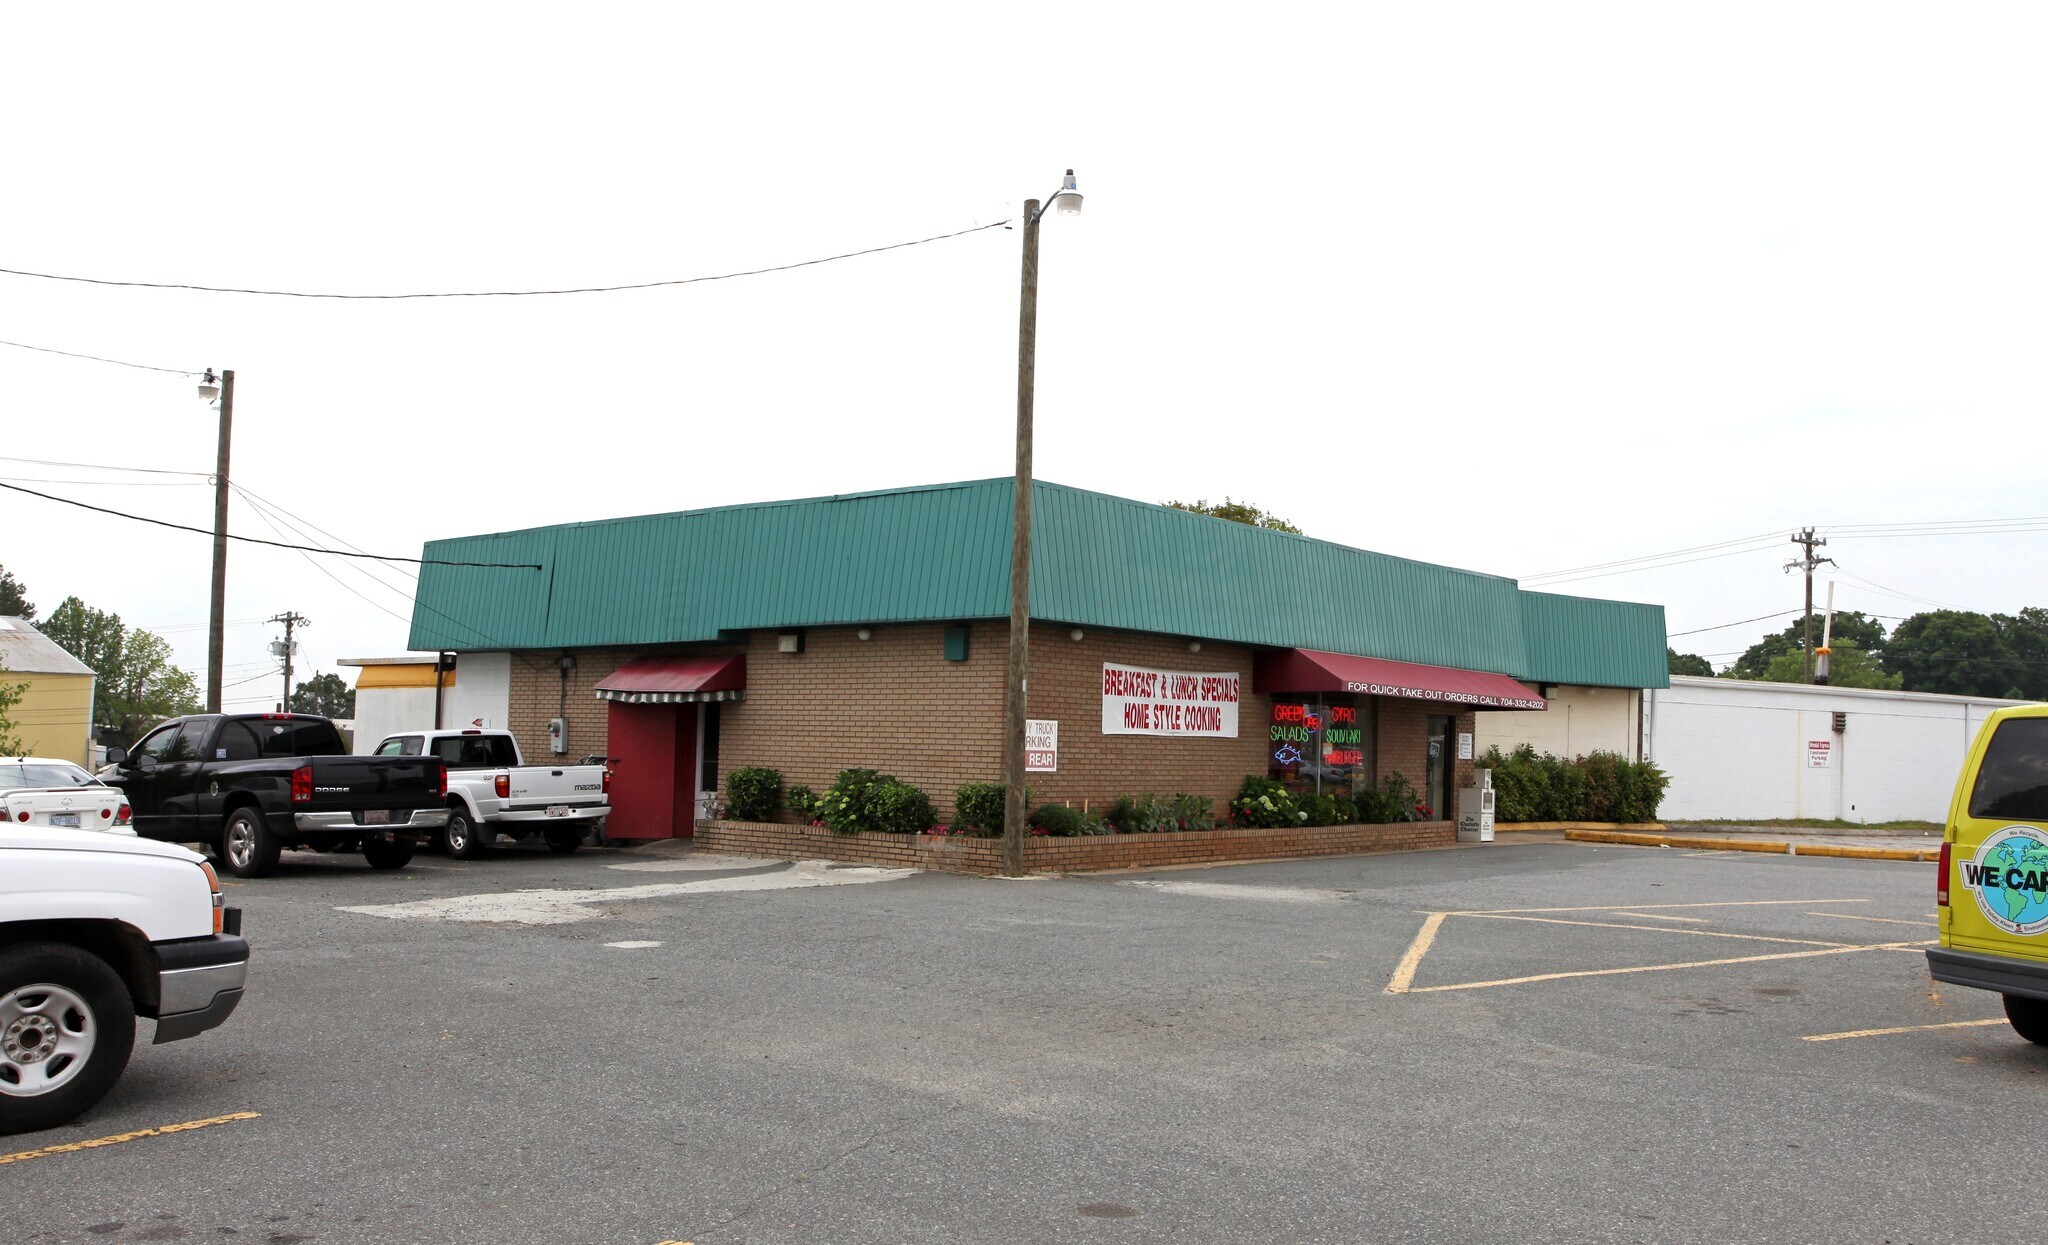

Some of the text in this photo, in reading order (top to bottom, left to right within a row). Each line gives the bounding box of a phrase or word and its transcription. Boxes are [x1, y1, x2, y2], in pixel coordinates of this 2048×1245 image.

[1104, 668, 1238, 703] BREAKFAST & LUNCH SPECIALS
[1348, 682, 1544, 710] FOR QUICK TAKE OUT ORDERS CALL 704-332-4202
[1124, 702, 1221, 732] HOME STYLE COOKING
[1303, 716, 1318, 730] OPE
[1331, 706, 1357, 723] GYRO
[1025, 736, 1051, 748] RKING
[1270, 725, 1309, 742] SALADS
[1326, 728, 1361, 744] SOUVLAKI
[1029, 753, 1053, 766] REAR
[1965, 863, 2000, 887] WE
